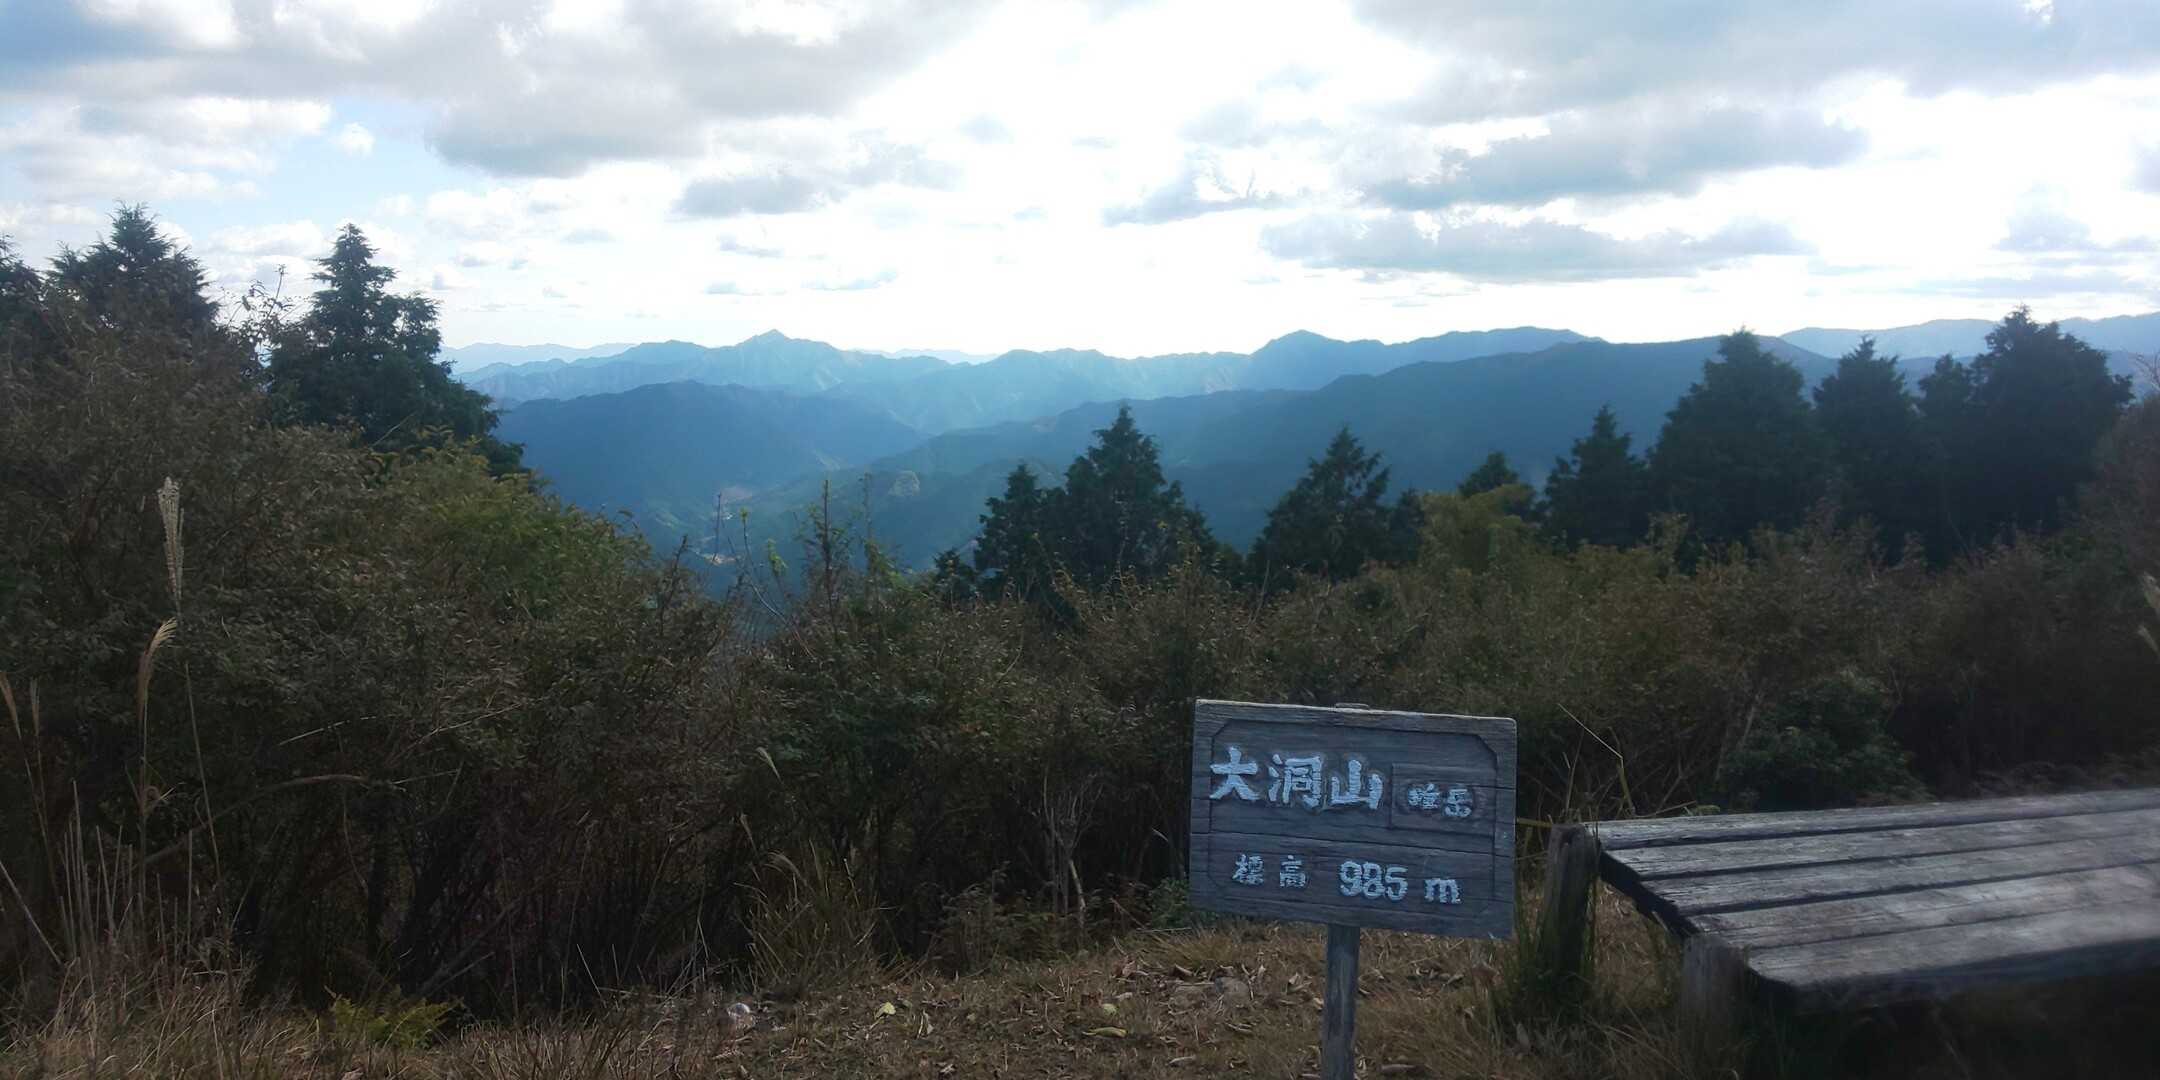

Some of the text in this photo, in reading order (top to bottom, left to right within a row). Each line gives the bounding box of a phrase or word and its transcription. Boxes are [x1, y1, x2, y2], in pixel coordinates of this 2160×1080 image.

[1208, 745, 1384, 811] 大洞山
[1232, 853, 1462, 904] 標高 985 m
